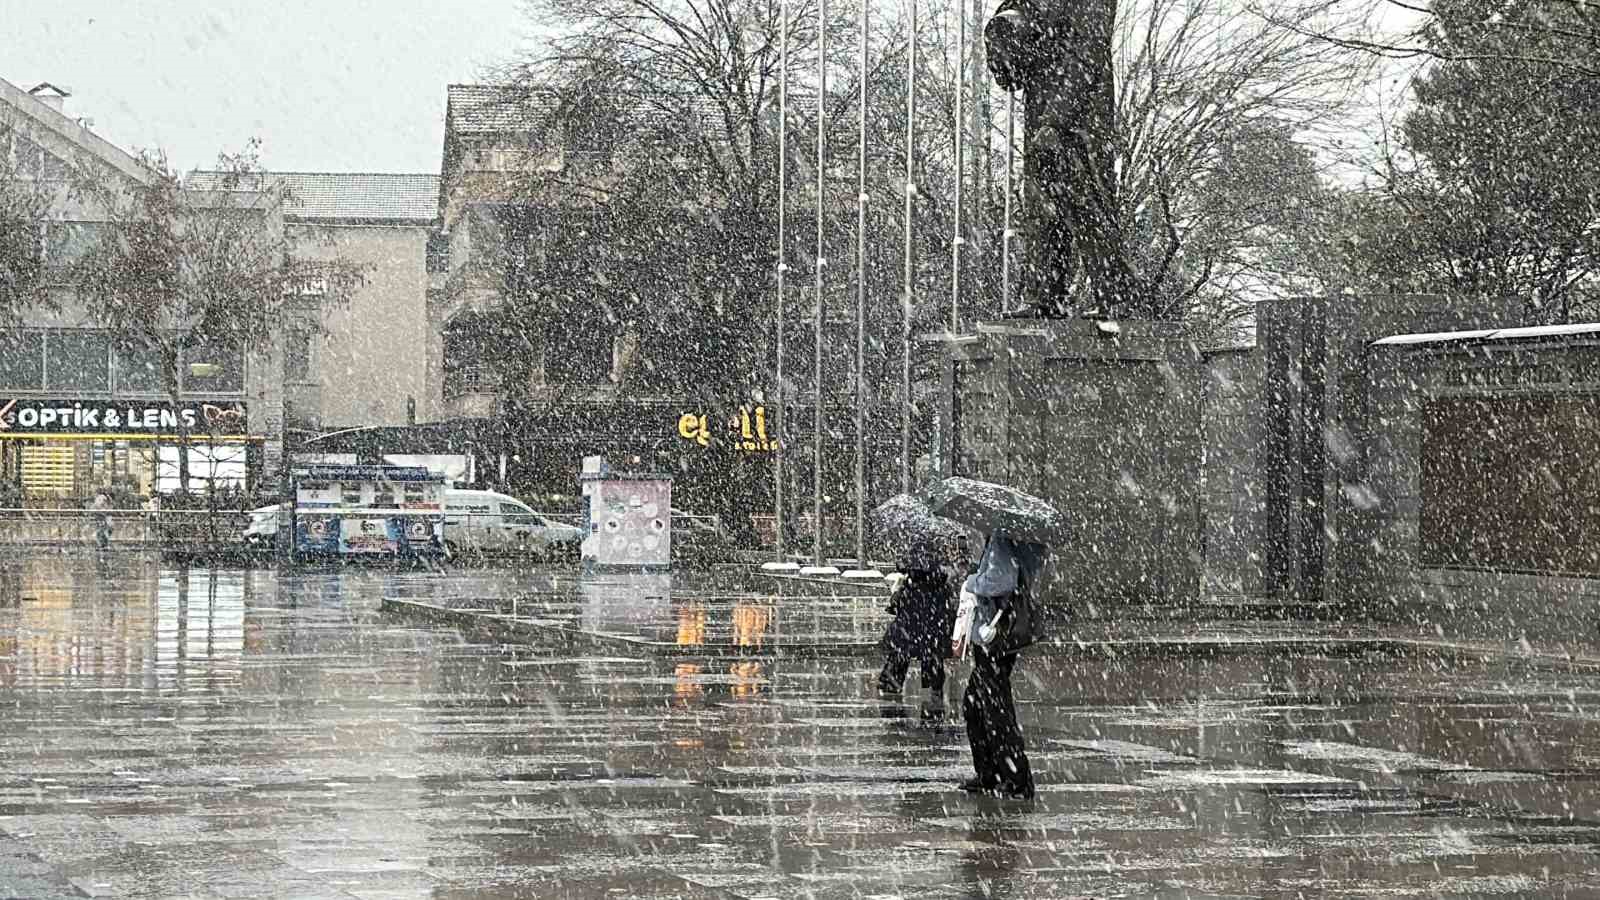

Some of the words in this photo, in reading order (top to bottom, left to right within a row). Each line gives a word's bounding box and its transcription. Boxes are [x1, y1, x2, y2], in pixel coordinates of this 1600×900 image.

[18, 402, 98, 427] OPTİK
[104, 408, 121, 428] &
[127, 409, 196, 428] LENS
